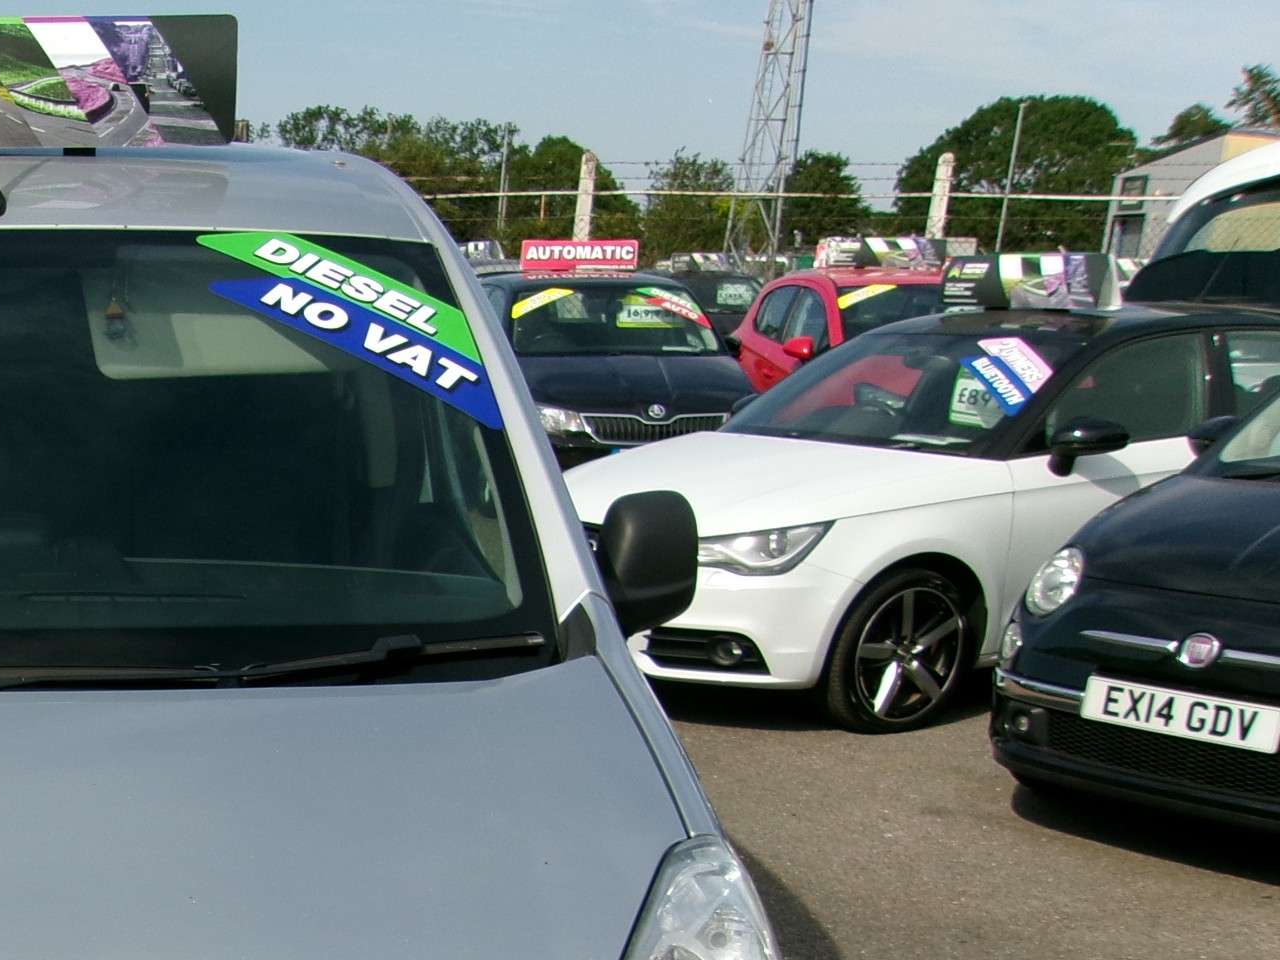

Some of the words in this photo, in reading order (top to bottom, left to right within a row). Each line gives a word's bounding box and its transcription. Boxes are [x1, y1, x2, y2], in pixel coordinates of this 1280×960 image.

[525, 245, 635, 260] AUTOMATIC
[253, 238, 438, 335] DIESEL
[661, 301, 699, 319] AUTO
[260, 283, 350, 330] NO
[363, 322, 479, 390] VAT
[970, 356, 1025, 406] BLUETOOTH
[1102, 685, 1176, 727] EX14
[1185, 701, 1258, 741] GDV
